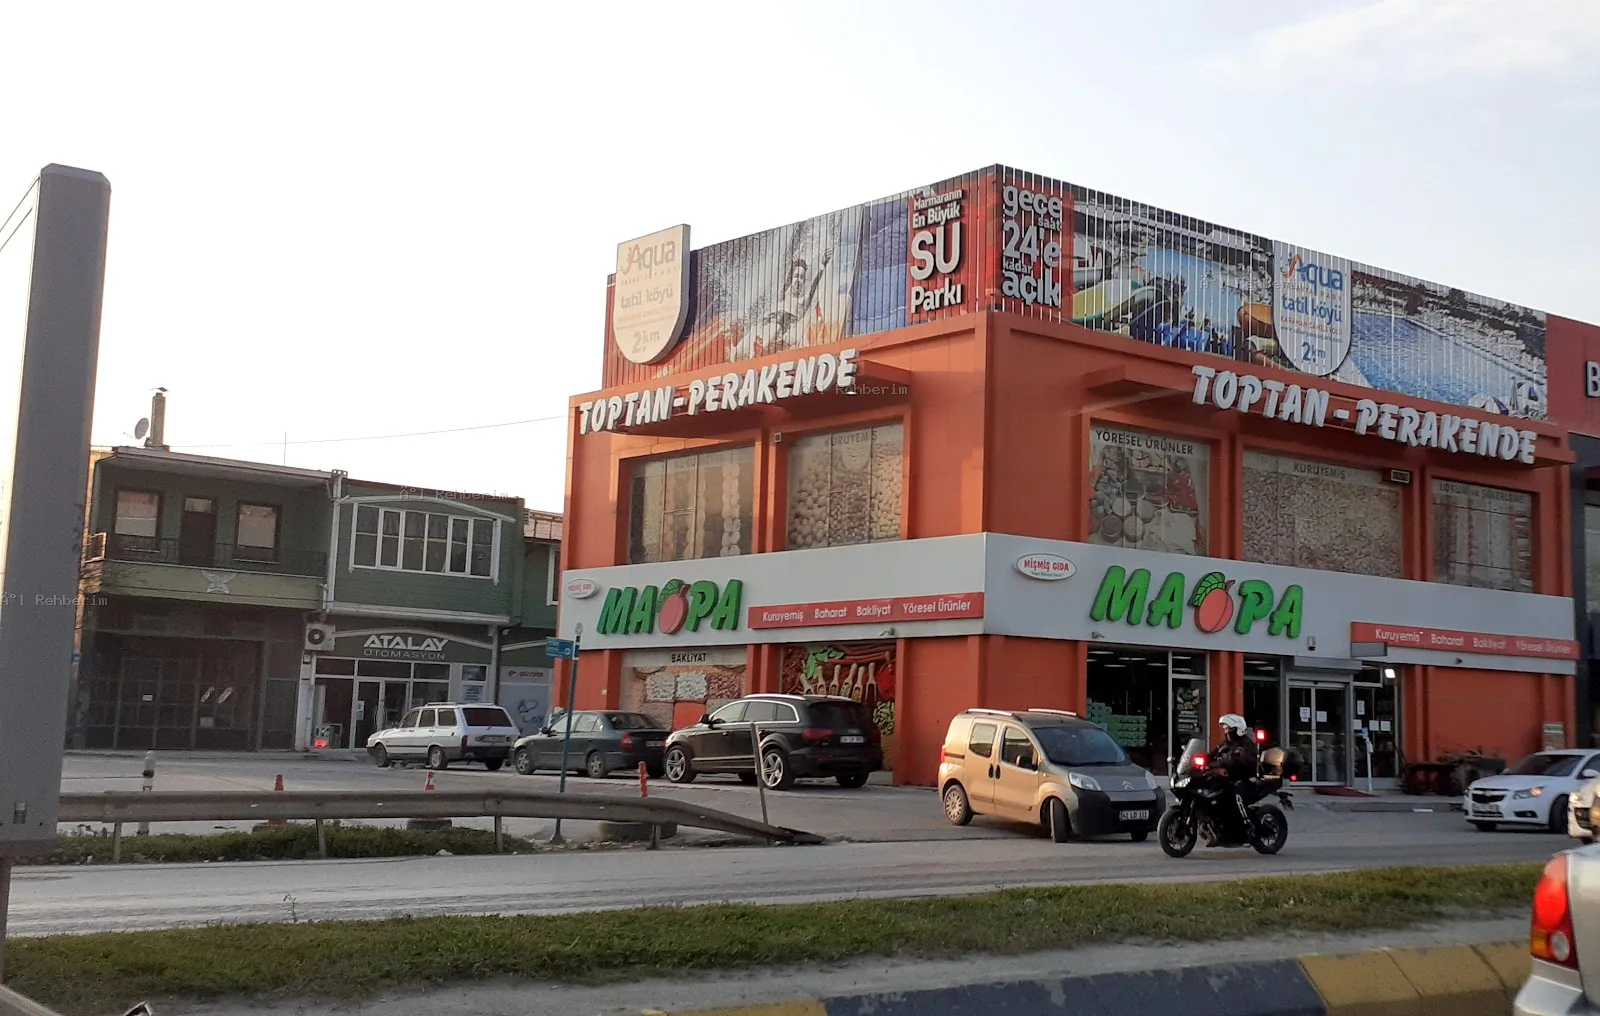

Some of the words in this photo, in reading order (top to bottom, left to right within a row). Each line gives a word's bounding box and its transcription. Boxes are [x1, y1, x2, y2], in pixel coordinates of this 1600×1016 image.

[912, 213, 925, 229] En
[927, 201, 960, 225] Büyük
[1038, 217, 1061, 231] saat
[910, 221, 961, 281] SU
[1002, 257, 1032, 274] kadar
[646, 284, 674, 304] köyü
[911, 278, 962, 313] Parkı
[1002, 268, 1060, 306] açık
[1281, 294, 1309, 315] tatil
[1311, 301, 1343, 325] köyü
[1095, 428, 1142, 447] YÖRESEL
[1145, 436, 1193, 455] ÜRÜNLER
[762, 610, 804, 623] Kuruyemiş
[814, 607, 848, 619] Baharat
[856, 604, 891, 617] Bakliyat
[903, 601, 936, 614] Yöresel
[938, 598, 971, 612] Ürünler
[363, 634, 449, 652] ATALAY
[1431, 633, 1464, 646] Baharat
[363, 648, 445, 660] OTOMASYON
